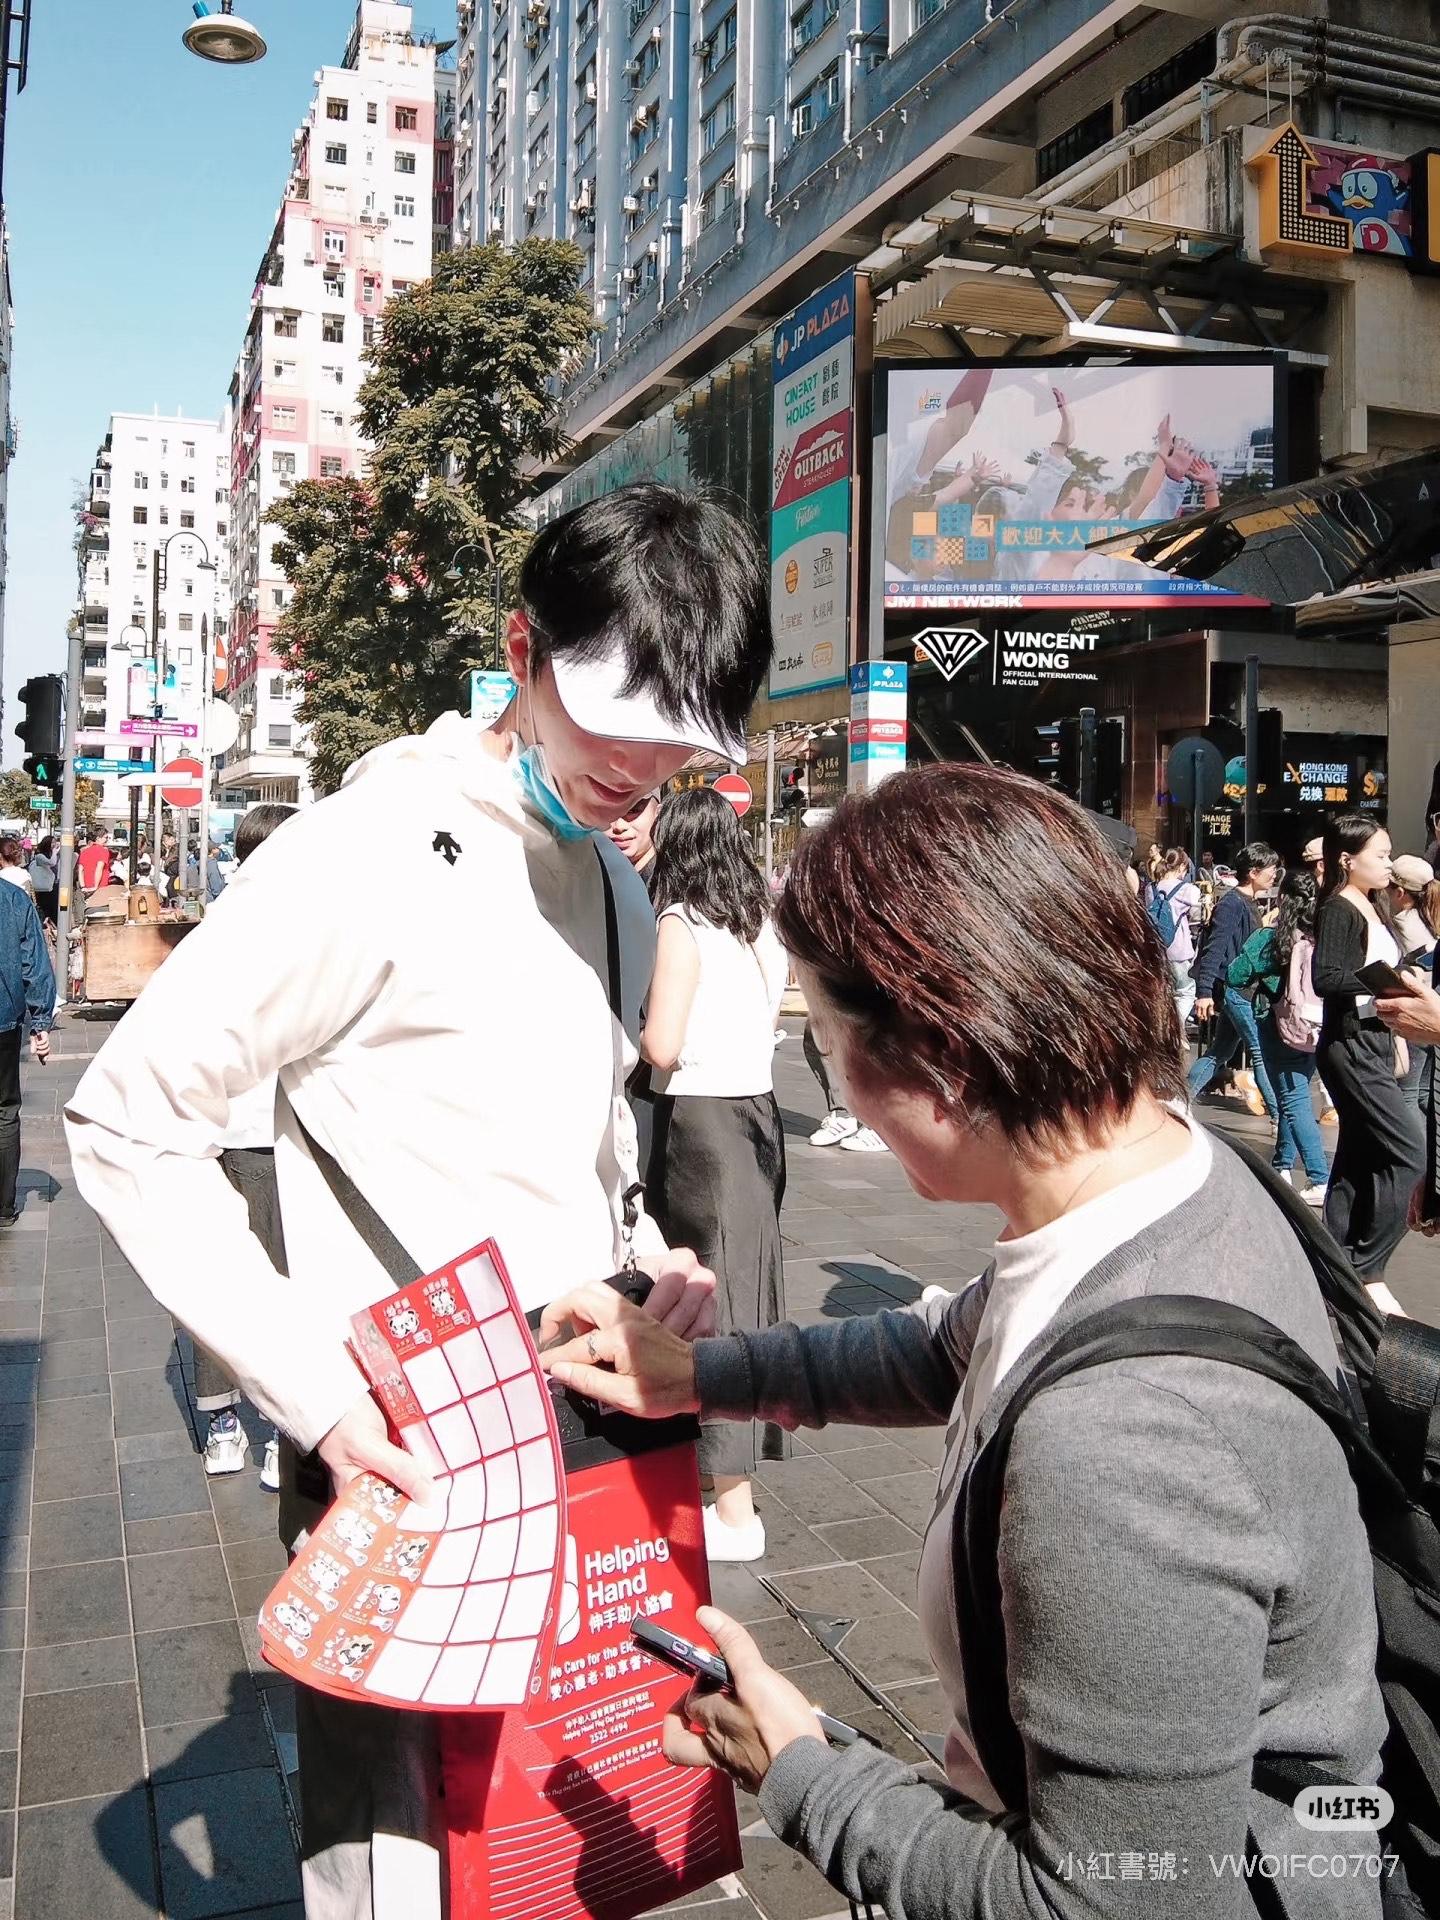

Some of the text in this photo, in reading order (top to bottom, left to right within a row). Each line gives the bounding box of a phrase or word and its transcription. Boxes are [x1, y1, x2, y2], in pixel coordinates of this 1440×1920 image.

[1362, 222, 1389, 251] D
[791, 293, 849, 352] JP PLAZA
[784, 372, 818, 407] CINEART
[786, 397, 816, 428] HOUSE
[774, 444, 786, 477] NOW
[794, 440, 844, 480] OUTBACK
[885, 595, 1024, 608] JM NETWORK
[1283, 766, 1348, 784] EXCHANGE
[1300, 763, 1348, 772] HONG KONG
[584, 1536, 670, 1580] Helping
[587, 1569, 648, 1609] Hand
[563, 1657, 586, 1676] Care
[587, 1650, 602, 1667] for
[602, 1644, 619, 1662] the
